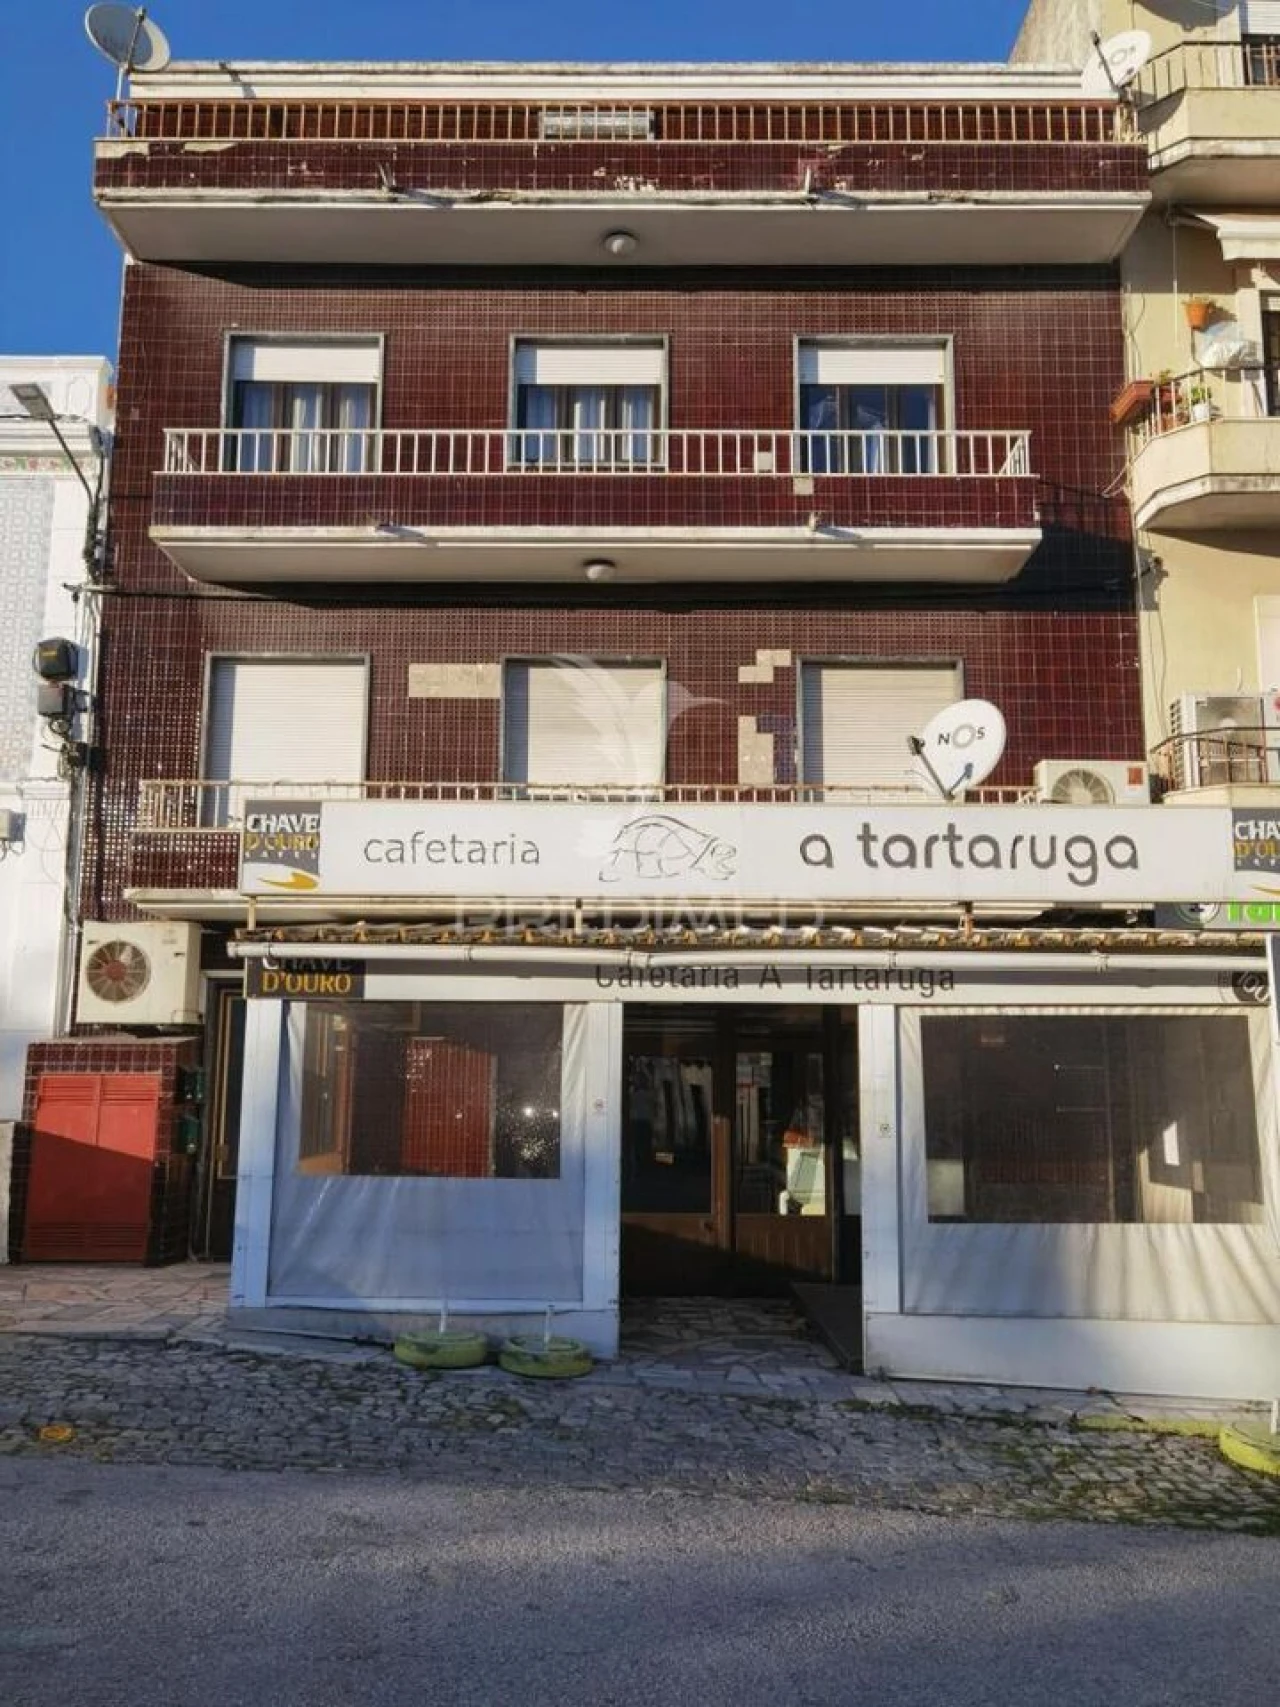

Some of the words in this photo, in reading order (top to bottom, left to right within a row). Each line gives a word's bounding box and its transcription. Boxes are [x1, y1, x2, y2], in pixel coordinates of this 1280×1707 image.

[938, 724, 986, 749] NOS
[246, 813, 320, 833] CHAVE
[1235, 820, 1280, 841] CHA
[363, 829, 540, 865] cafetaria
[799, 833, 834, 869] a
[857, 822, 1139, 888] tartaruga
[261, 972, 352, 993] D'OURO
